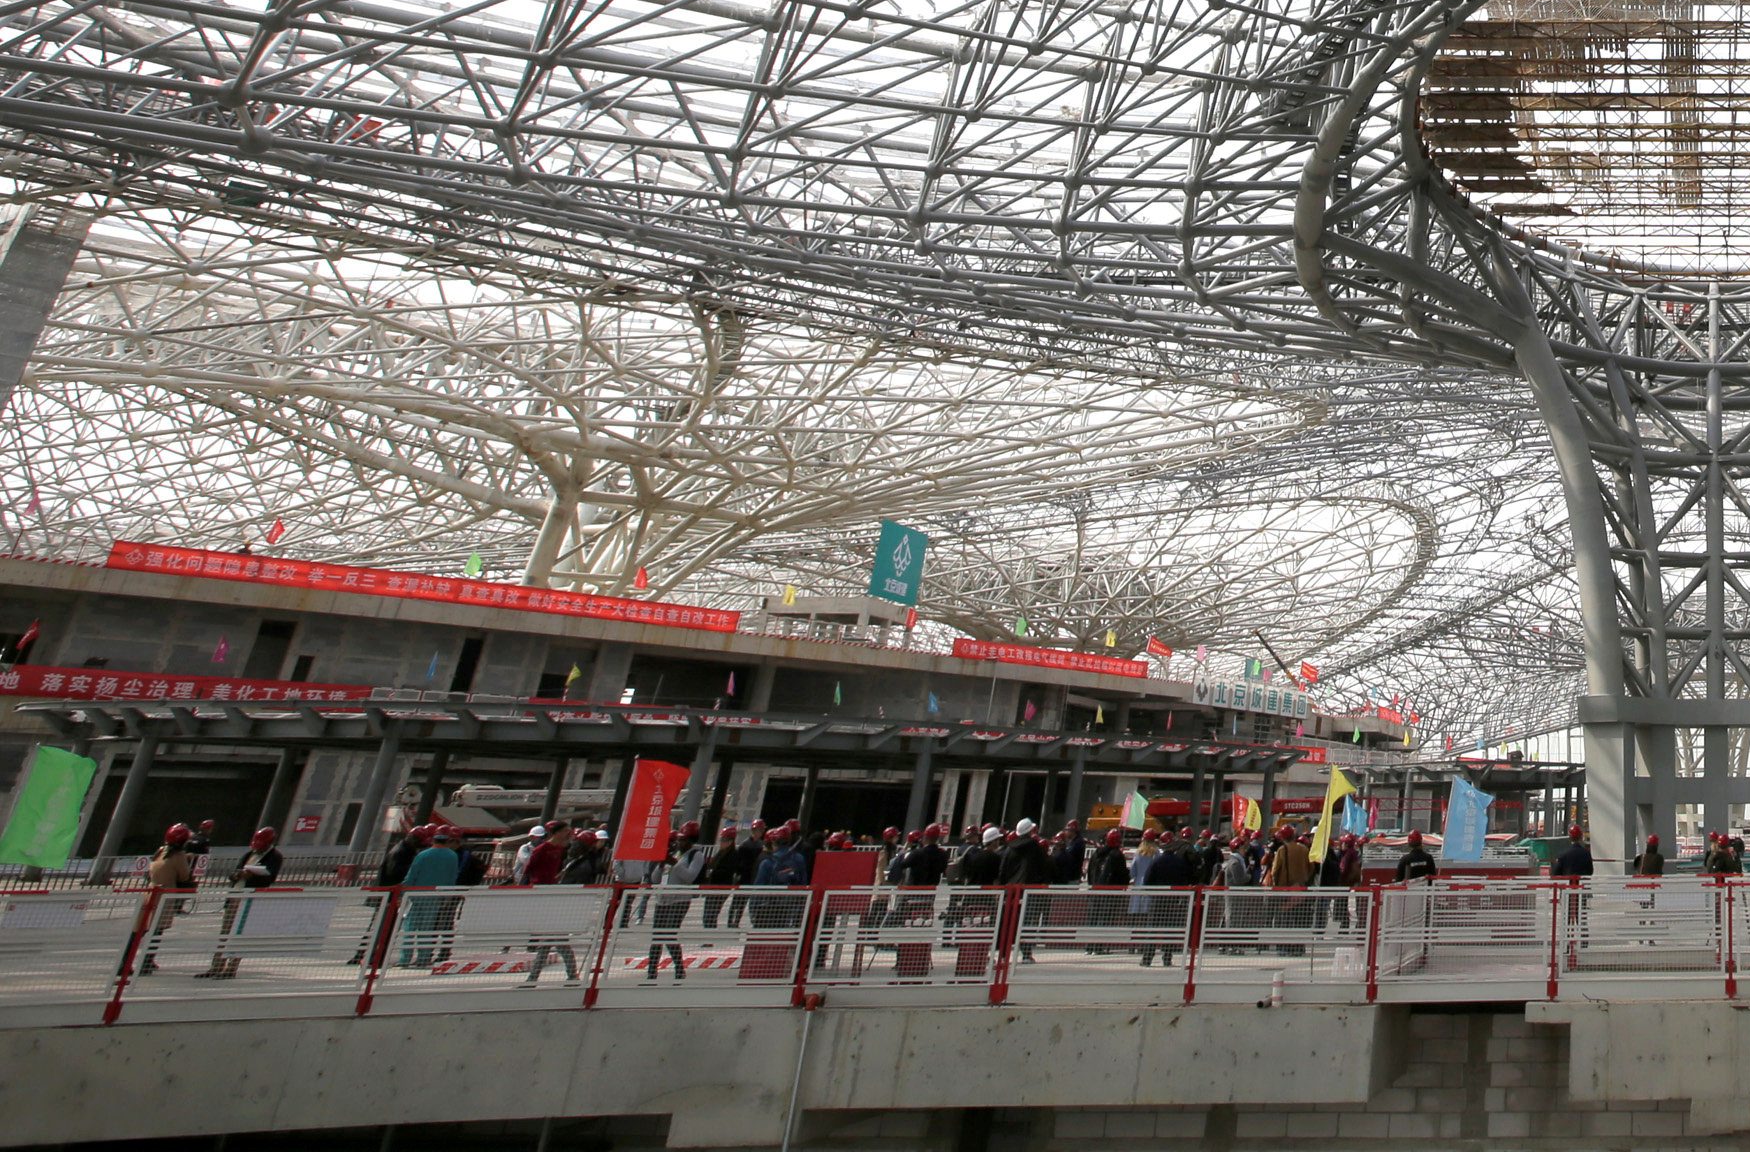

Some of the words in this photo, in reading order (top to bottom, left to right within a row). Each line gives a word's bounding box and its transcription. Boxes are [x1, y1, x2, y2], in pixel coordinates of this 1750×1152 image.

[145, 550, 297, 580] 强化问题隐患整改
[307, 567, 376, 587] 举一反三
[386, 575, 450, 596] 查漏补缺
[458, 583, 520, 604] 真查真改
[527, 591, 730, 627] 做好安全生产大检查自查自改工作
[40, 672, 196, 698] 落实扬尘治理
[1214, 684, 1307, 715] 北京城建集团
